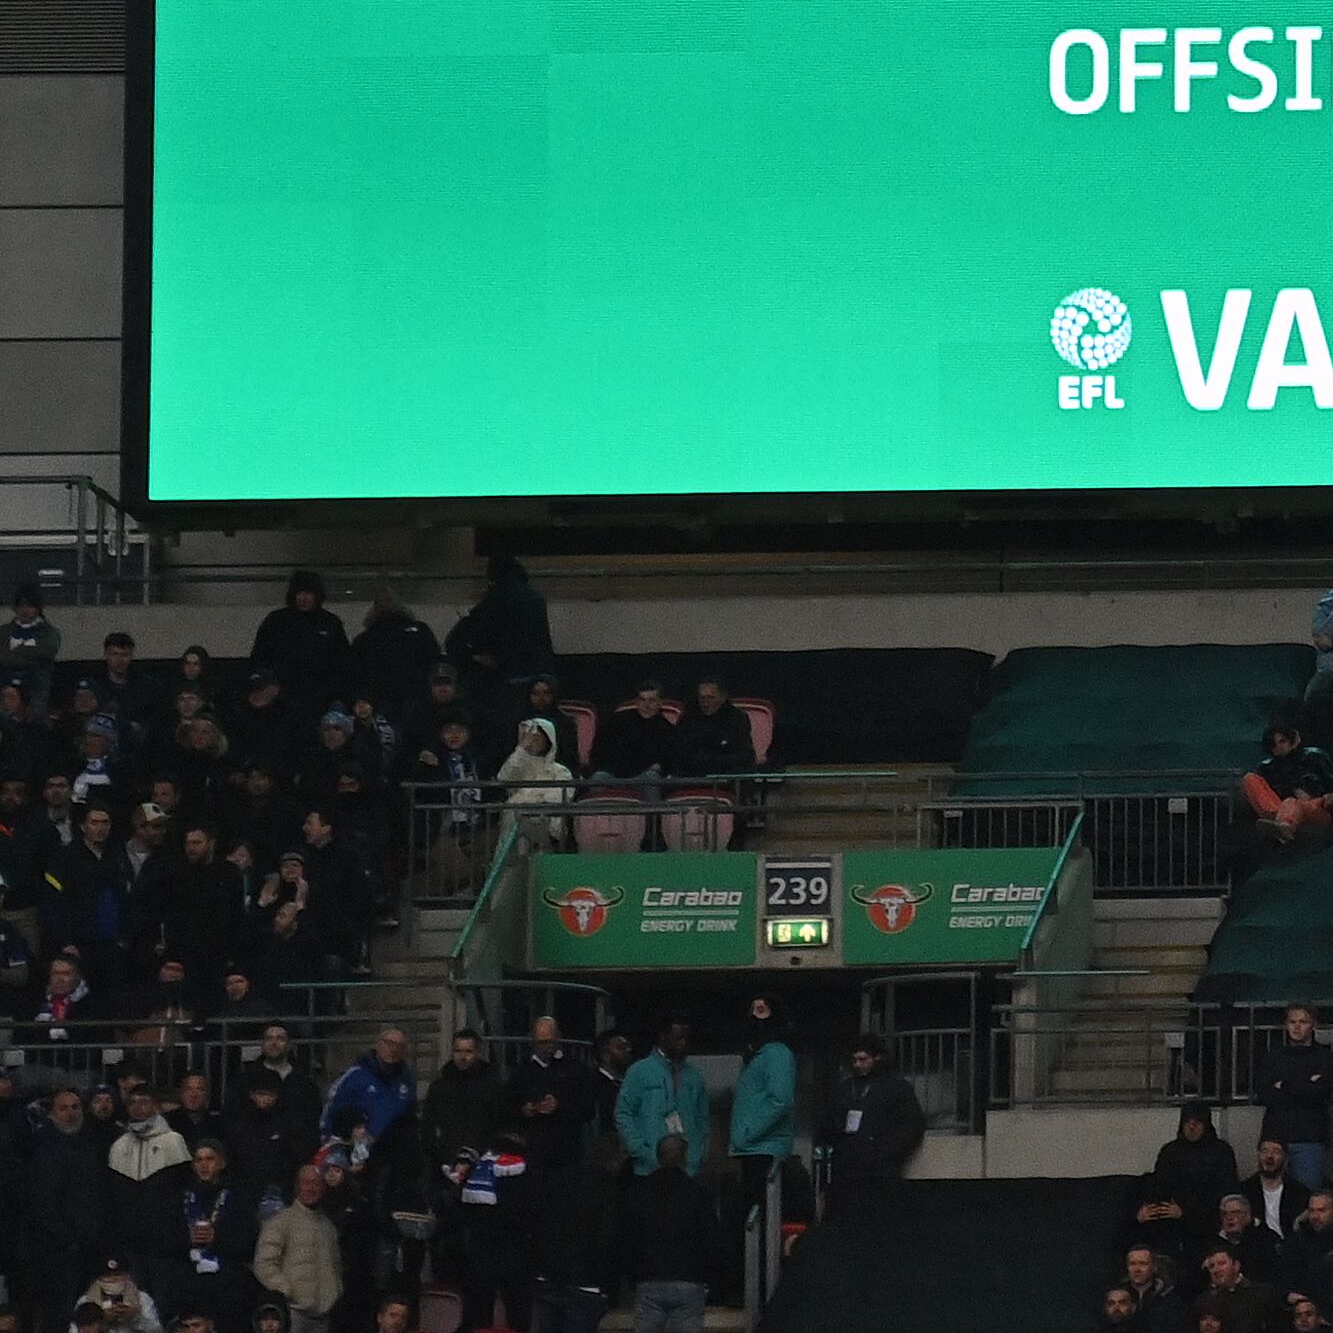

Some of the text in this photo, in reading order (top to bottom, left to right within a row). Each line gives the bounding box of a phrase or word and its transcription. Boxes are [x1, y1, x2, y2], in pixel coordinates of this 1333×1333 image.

[1058, 375, 1126, 410] EFL
[642, 886, 743, 906] Carabao
[768, 877, 828, 906] 239
[640, 919, 694, 933] ENERGY
[948, 915, 1003, 929] ENERGY
